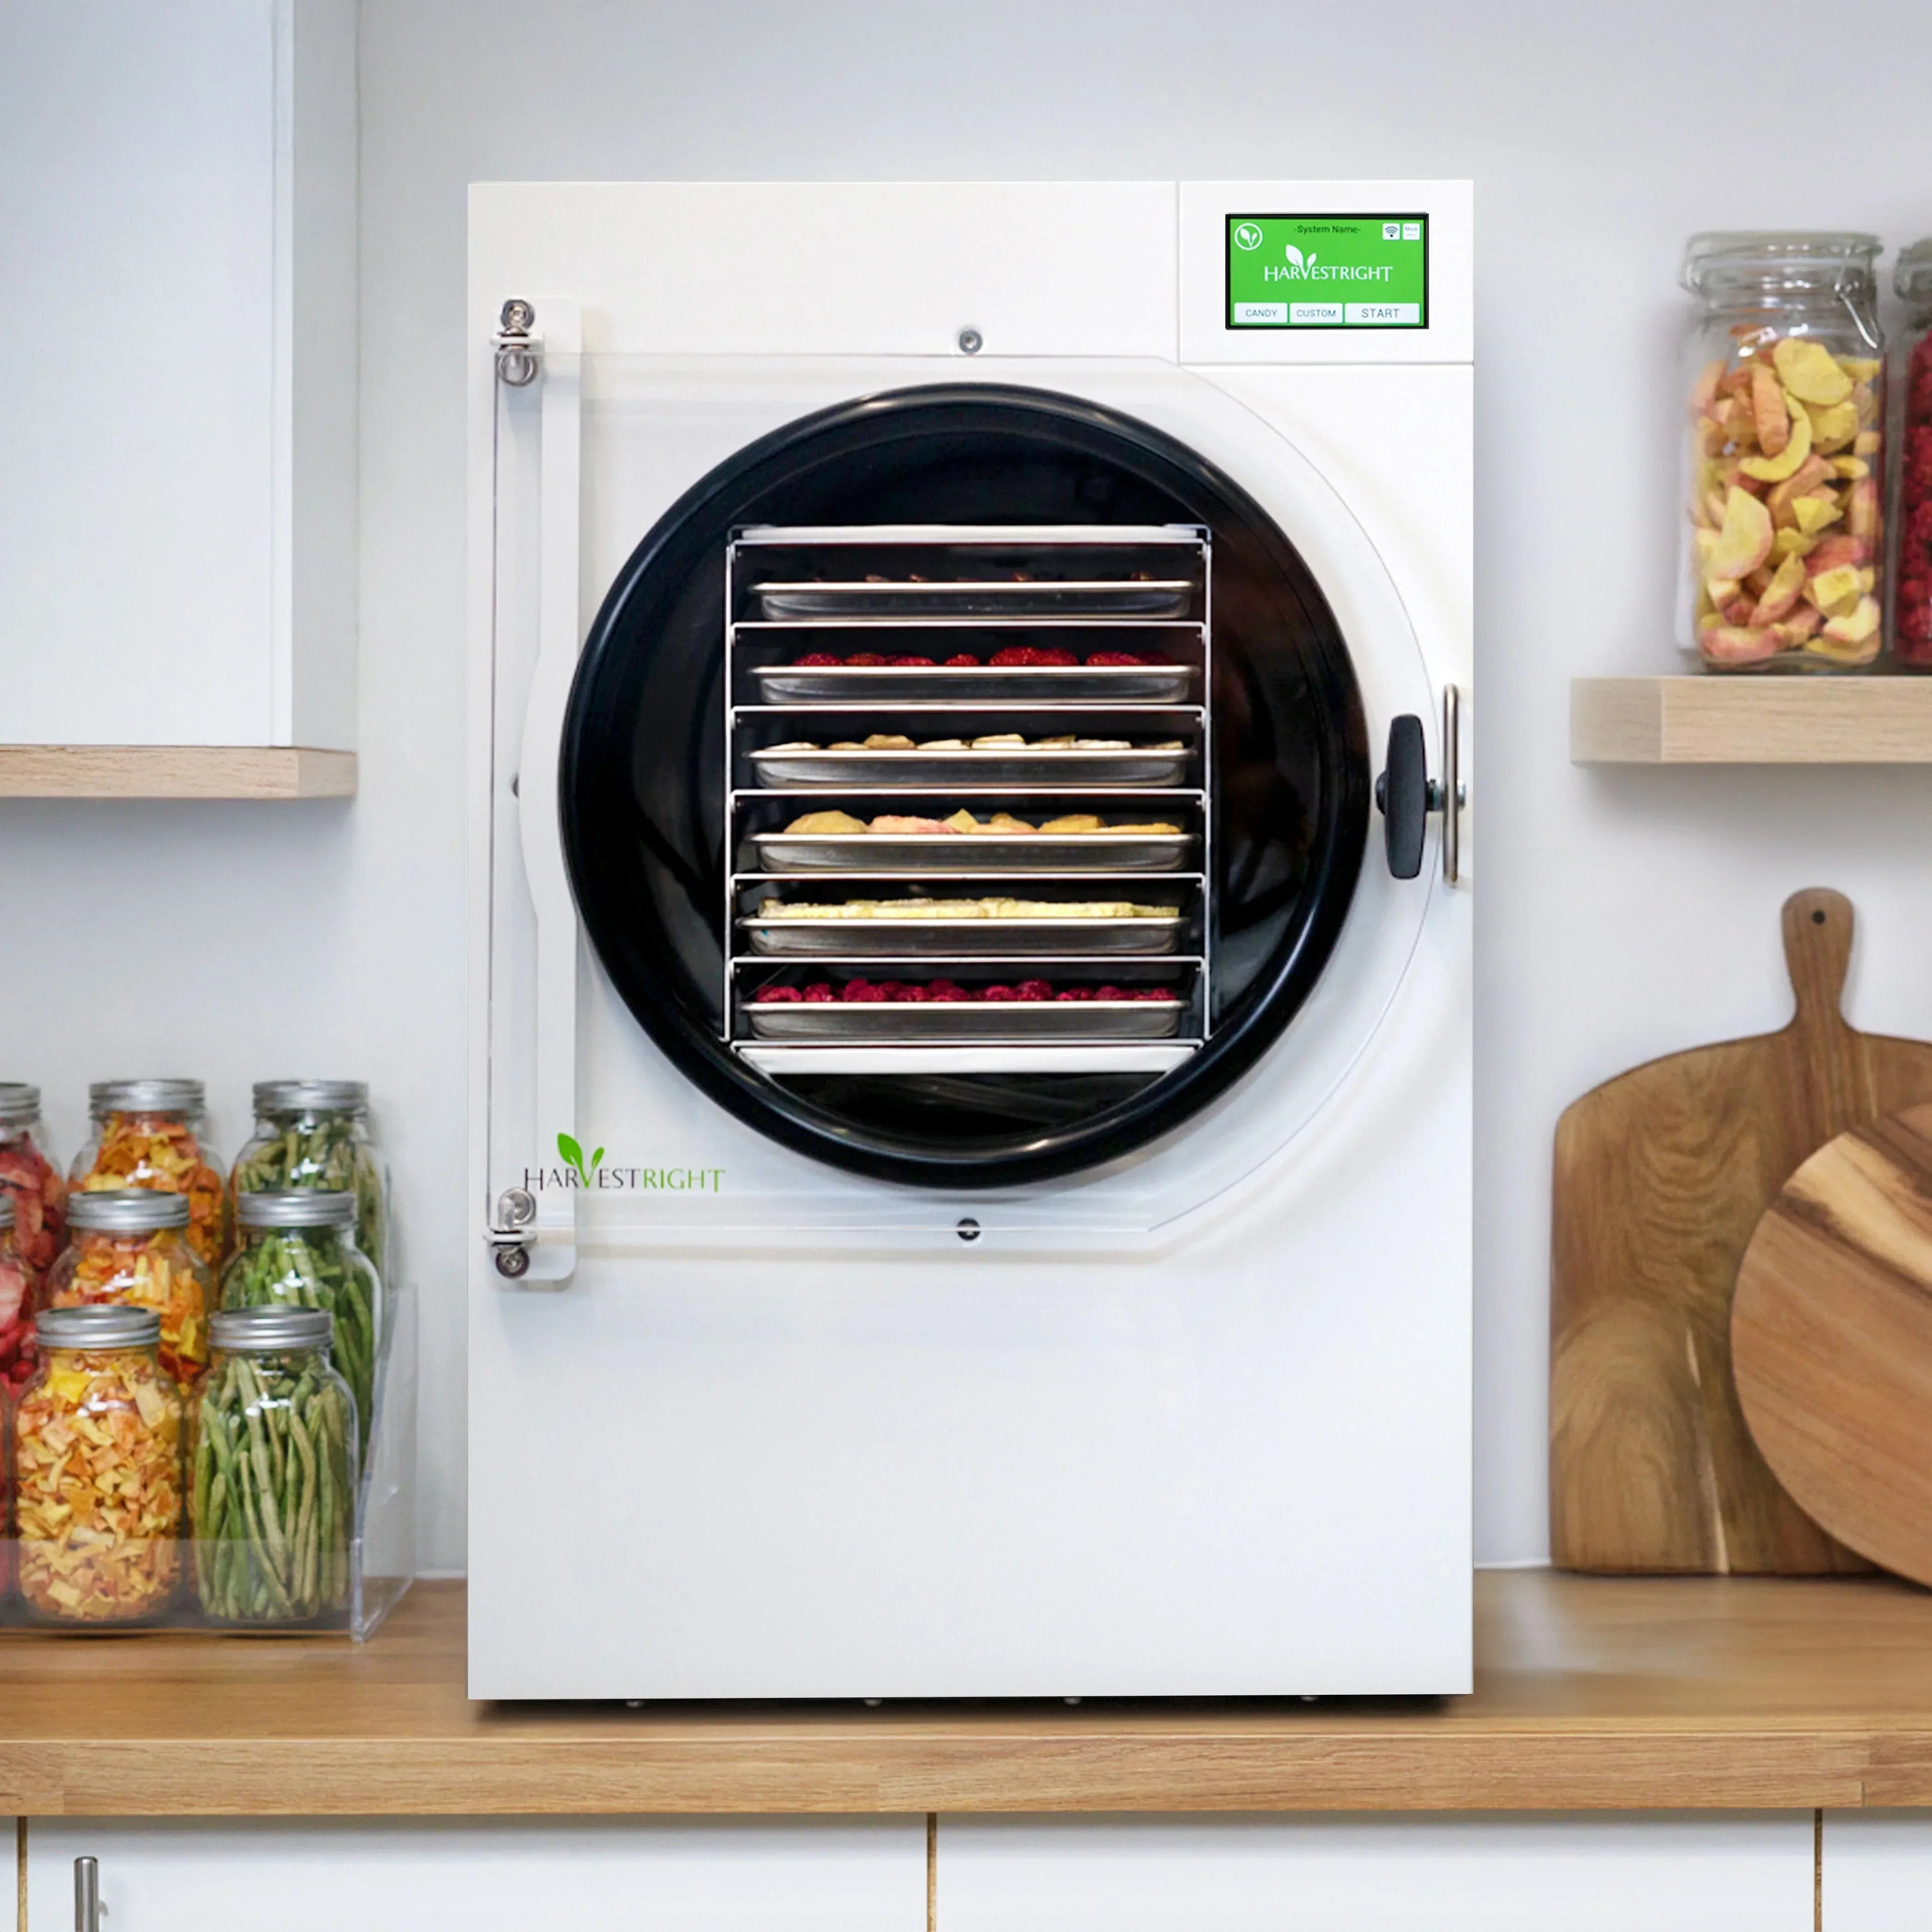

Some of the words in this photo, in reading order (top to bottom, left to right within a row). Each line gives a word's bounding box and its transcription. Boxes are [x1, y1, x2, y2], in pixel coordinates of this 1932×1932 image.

[1245, 309, 1278, 318] CANDY
[1296, 309, 1336, 318] CUSTOM
[1361, 308, 1400, 318] START
